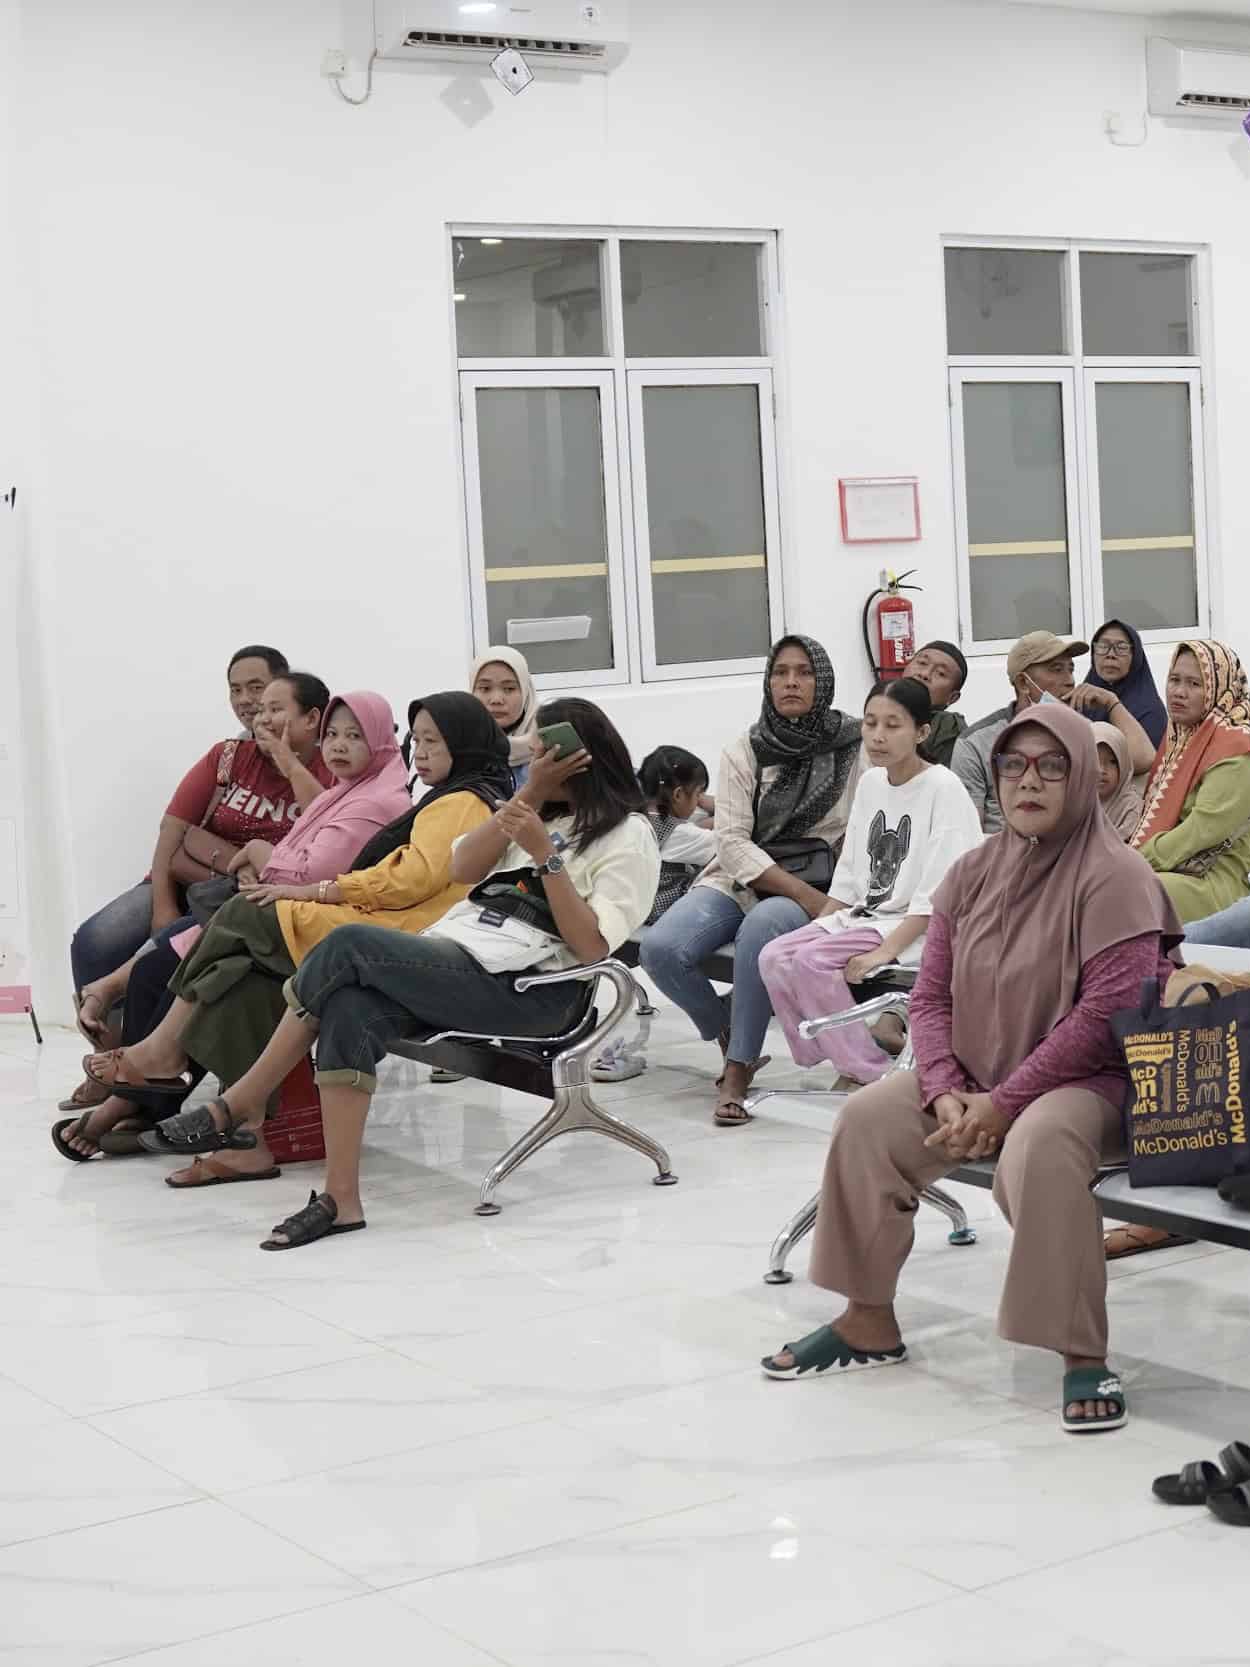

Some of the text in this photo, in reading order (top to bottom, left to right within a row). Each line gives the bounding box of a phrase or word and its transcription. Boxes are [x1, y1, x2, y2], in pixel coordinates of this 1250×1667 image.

[1135, 1079, 1157, 1098] n
[1176, 1029, 1192, 1113] McDonald's
[1225, 1019, 1247, 1144] McDonald's
[1133, 1128, 1228, 1156] McDonald's
